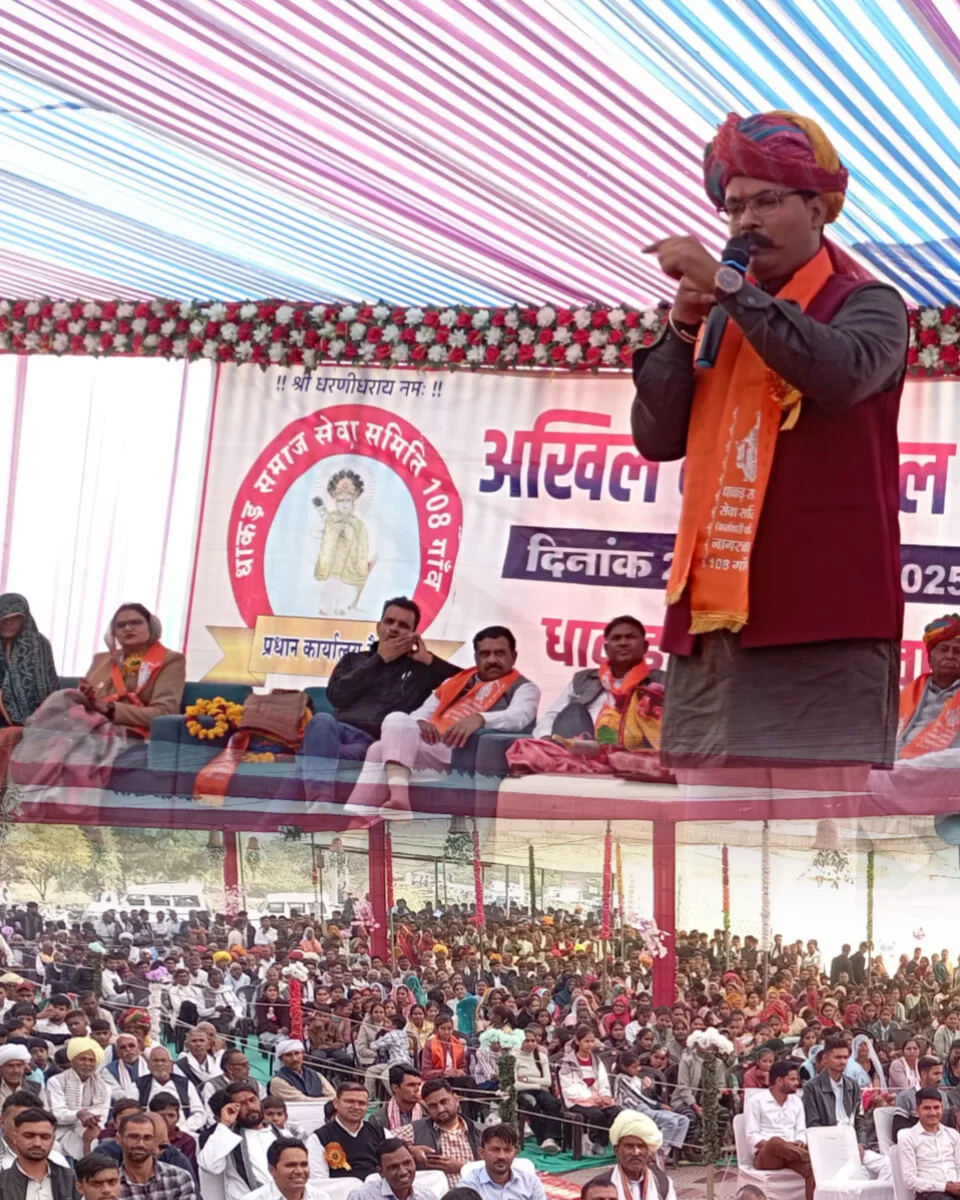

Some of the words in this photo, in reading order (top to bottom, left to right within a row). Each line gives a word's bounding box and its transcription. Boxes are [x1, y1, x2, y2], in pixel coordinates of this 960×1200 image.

[292, 373, 309, 392] श्री
[315, 372, 396, 396] धरणीधराय
[398, 380, 426, 397] नमः
[314, 415, 359, 448] सेवा
[365, 422, 428, 477] समिति
[253, 431, 309, 494] समाज
[422, 478, 451, 529] 108
[424, 538, 453, 591] गाँव
[525, 532, 654, 579] दिनांक
[261, 636, 299, 658] प्रधान
